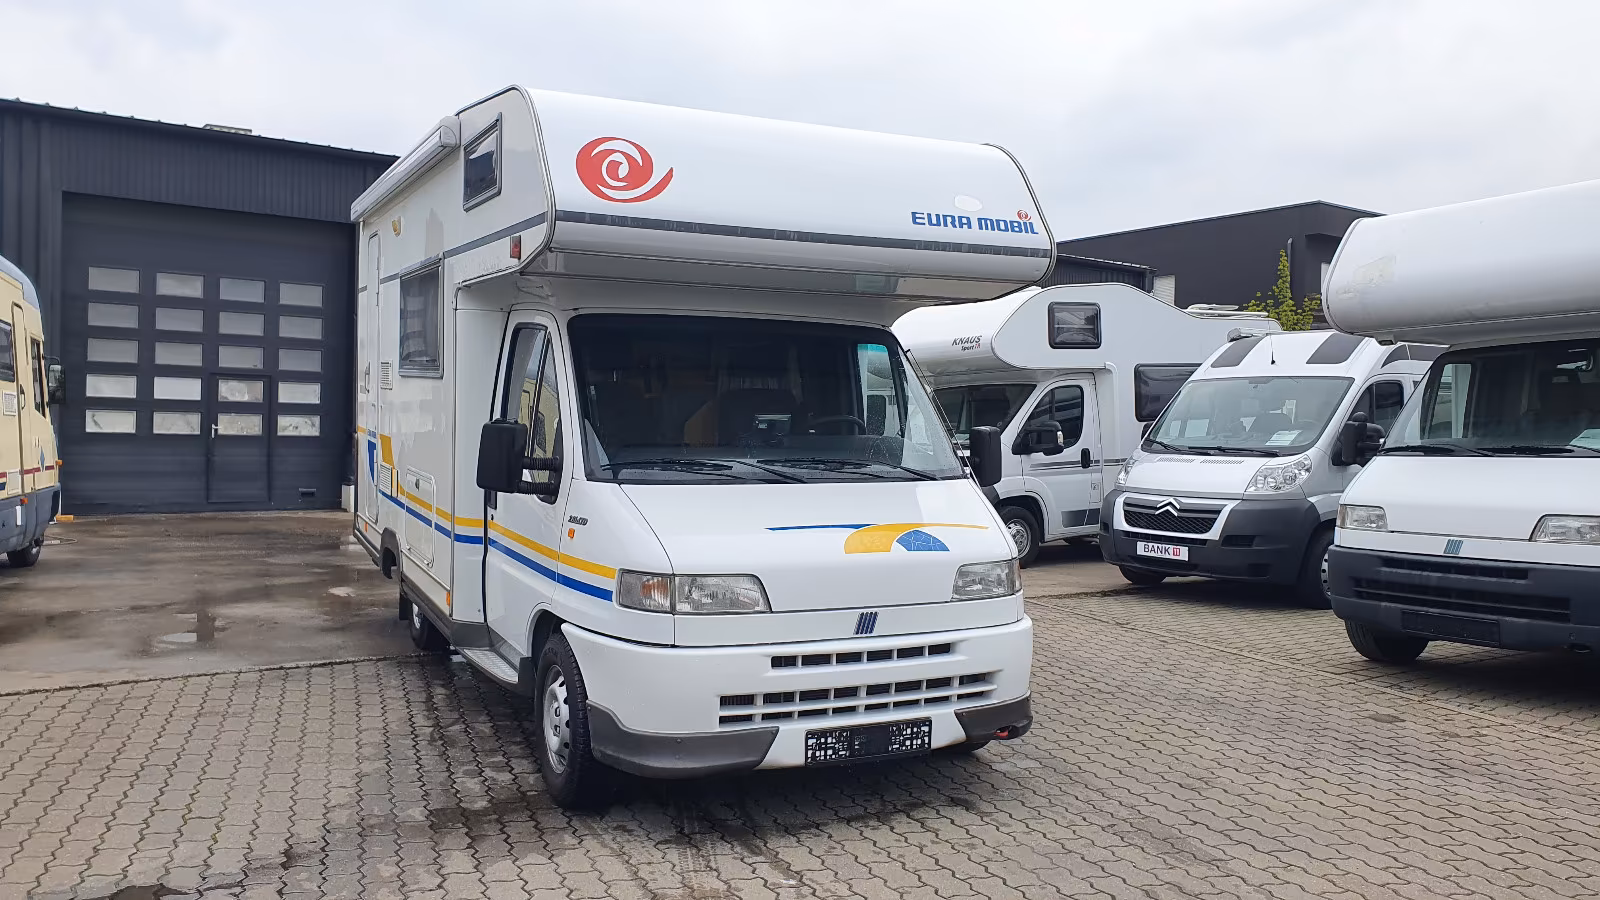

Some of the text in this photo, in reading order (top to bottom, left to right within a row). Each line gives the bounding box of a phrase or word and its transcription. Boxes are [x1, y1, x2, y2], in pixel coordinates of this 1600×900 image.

[911, 211, 1039, 234] EURA MOBIL
[952, 335, 982, 346] KNAUS
[1144, 544, 1170, 556] BANK
